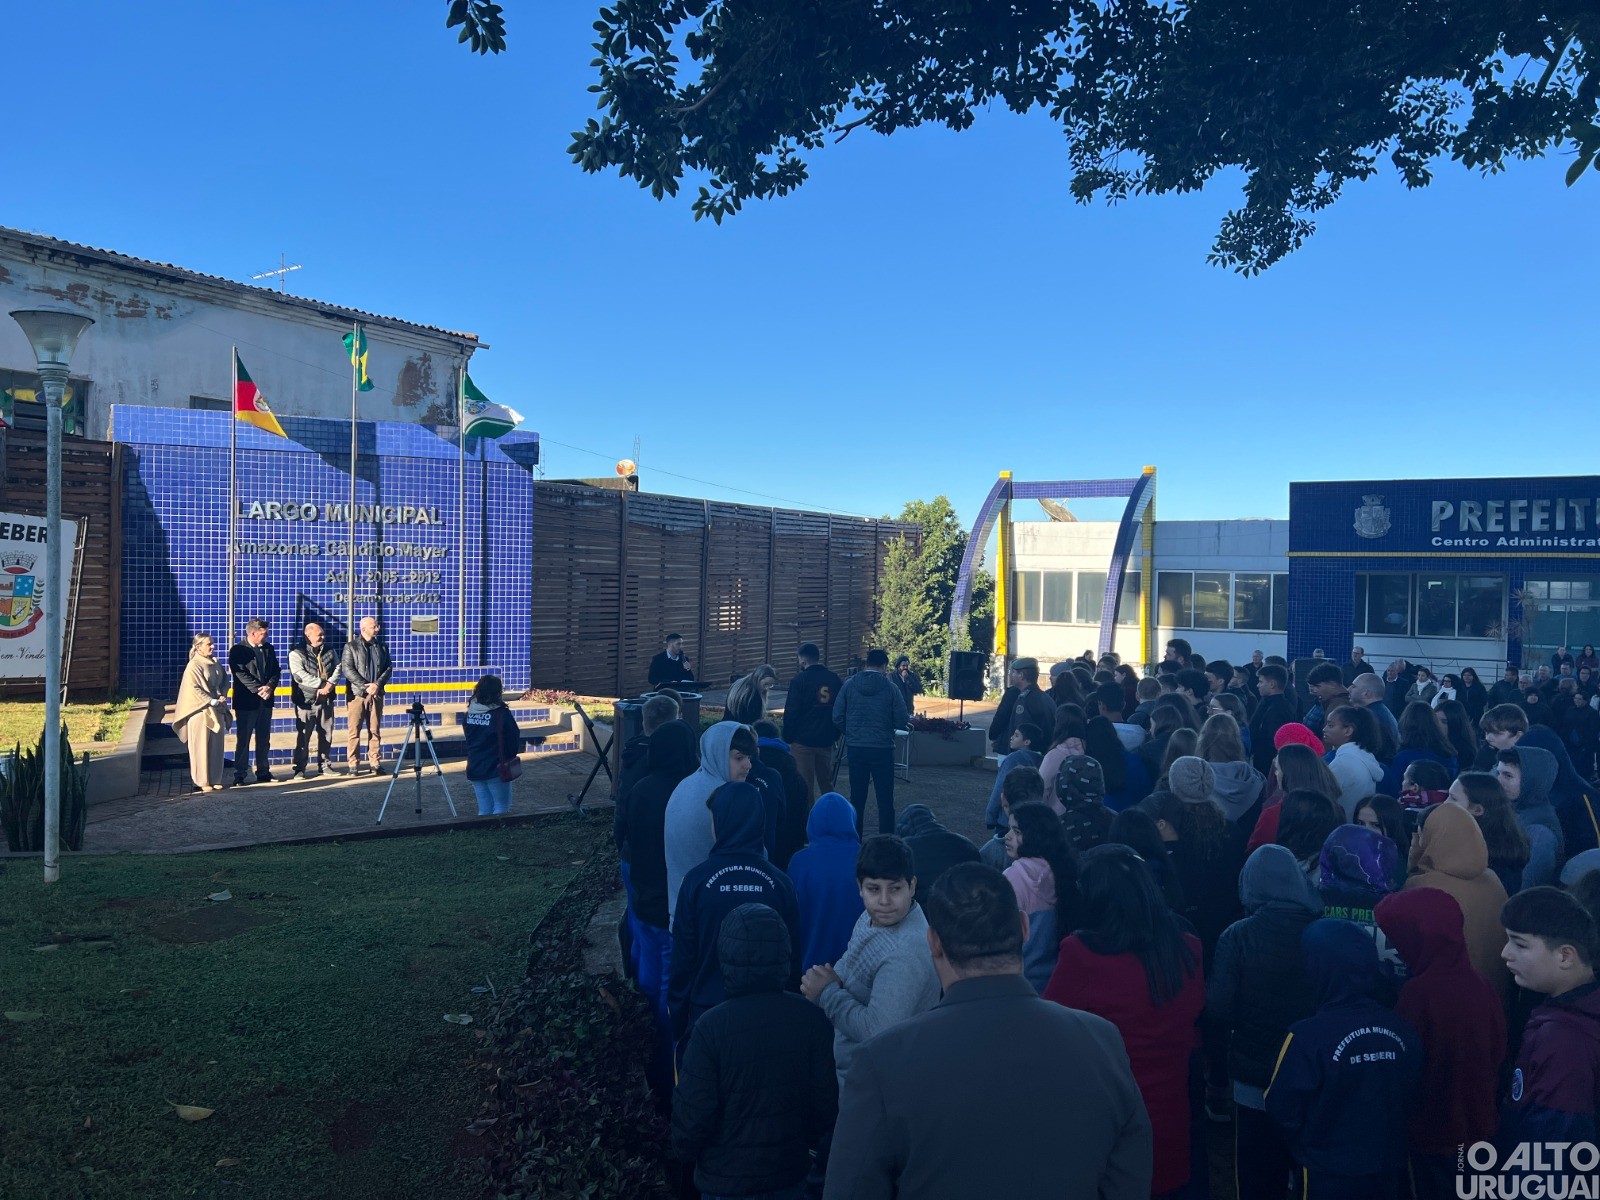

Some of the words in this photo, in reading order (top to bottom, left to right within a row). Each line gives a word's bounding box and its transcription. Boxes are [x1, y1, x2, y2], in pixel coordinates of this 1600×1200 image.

[236, 500, 318, 522] LARGO
[325, 503, 443, 525] MUNICIPAL
[1432, 497, 1600, 532] PREFEIT
[0, 522, 47, 543] EBER
[1432, 536, 1489, 547] Centro
[399, 542, 448, 560] Mayer
[410, 571, 441, 584] 2012
[413, 592, 441, 603] 2012
[706, 866, 743, 888] PREFEITURA
[745, 866, 775, 890] MUNICIPAL
[1333, 1027, 1371, 1061] PREFEITURA
[1350, 1056, 1362, 1064] DE
